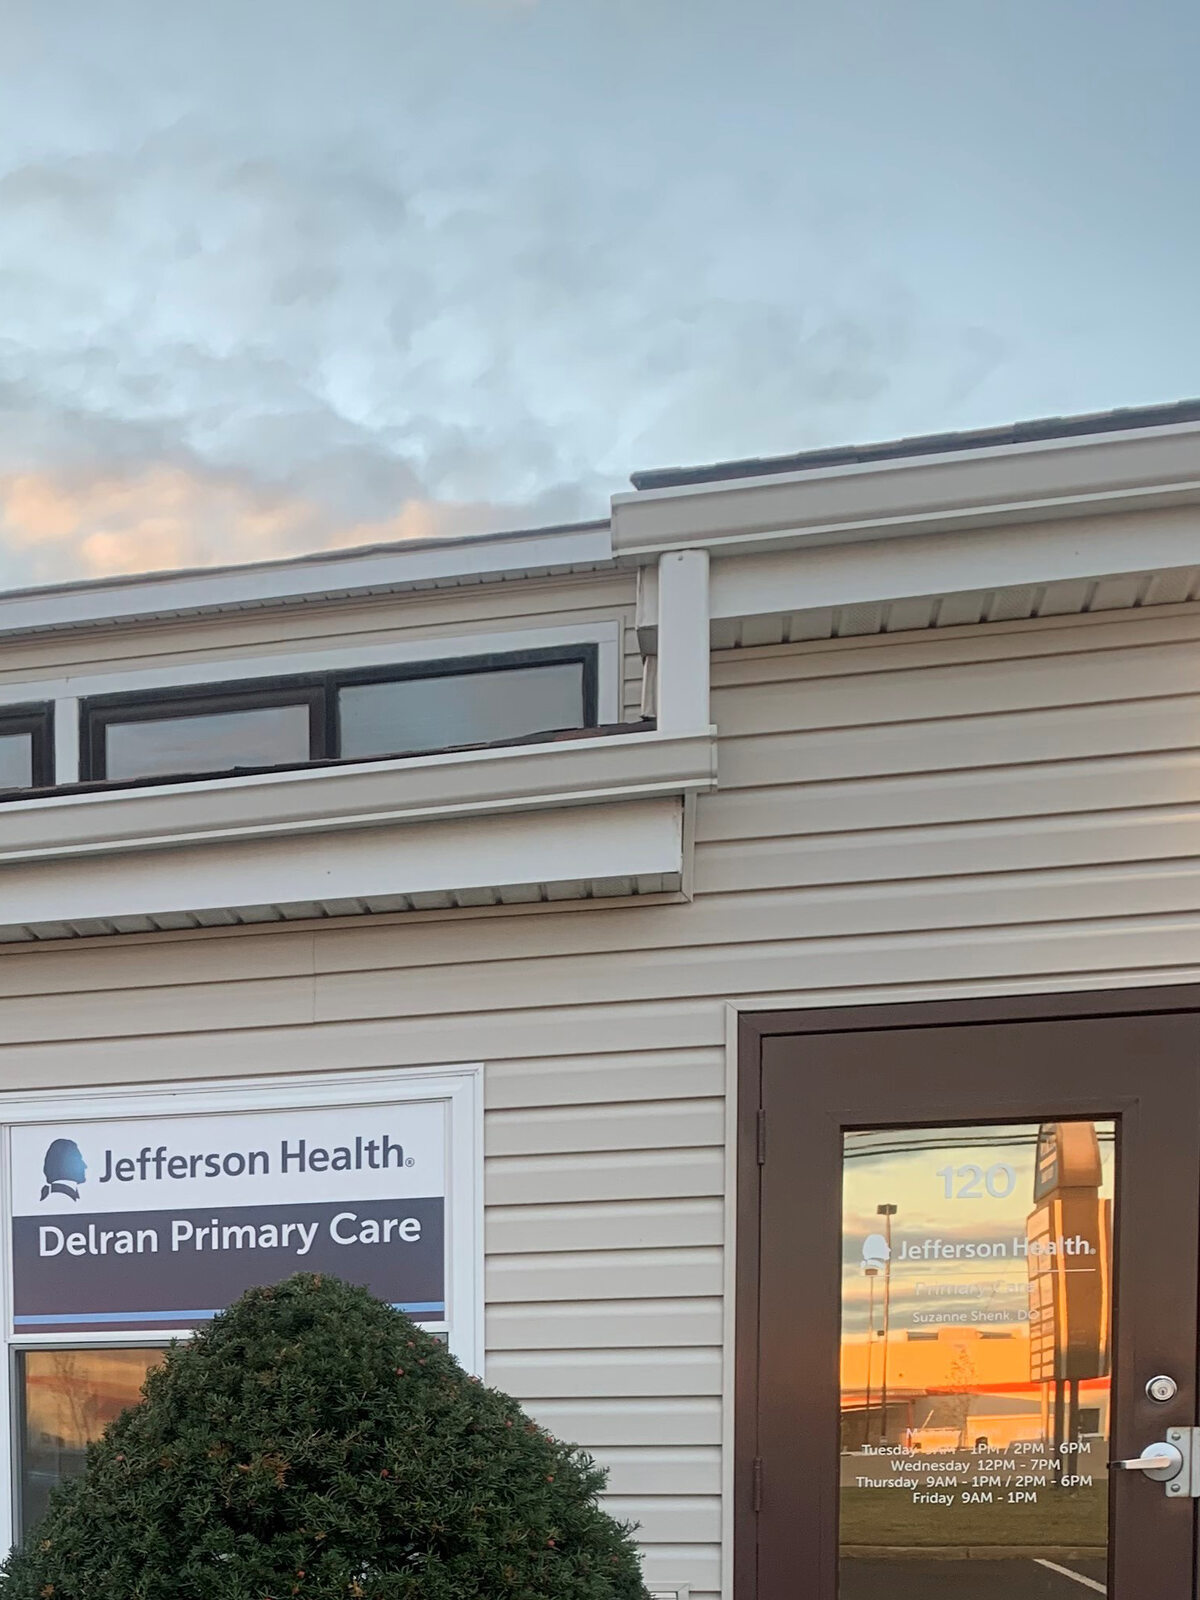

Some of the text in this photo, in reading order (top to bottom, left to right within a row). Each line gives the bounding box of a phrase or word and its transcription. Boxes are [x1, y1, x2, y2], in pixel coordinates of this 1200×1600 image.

[99, 1146, 269, 1183] Jefferson
[936, 1163, 1017, 1199] 120
[39, 1212, 421, 1257] Delran Primary Care
[898, 1239, 1006, 1260] Jefferson
[915, 1282, 985, 1297] Primary
[912, 1311, 968, 1323] Suzanne
[1017, 1309, 1040, 1321] DO
[861, 1444, 916, 1458] Tuesday
[970, 1444, 1000, 1455] 1PM
[1013, 1443, 1045, 1454] 2PM
[1059, 1442, 1091, 1454] 6PM
[891, 1460, 970, 1474] Wednesday
[977, 1459, 1016, 1471] 12PM
[1030, 1459, 1061, 1471] 7PM
[855, 1476, 919, 1490] Thursday
[926, 1476, 957, 1488] 9AM
[971, 1475, 1001, 1487] 1PM
[1015, 1475, 1046, 1487] 2PM
[1060, 1475, 1093, 1487] 6PM
[912, 1492, 955, 1506] Friday
[961, 1492, 993, 1504] 9AM
[1007, 1492, 1037, 1503] 1PM
